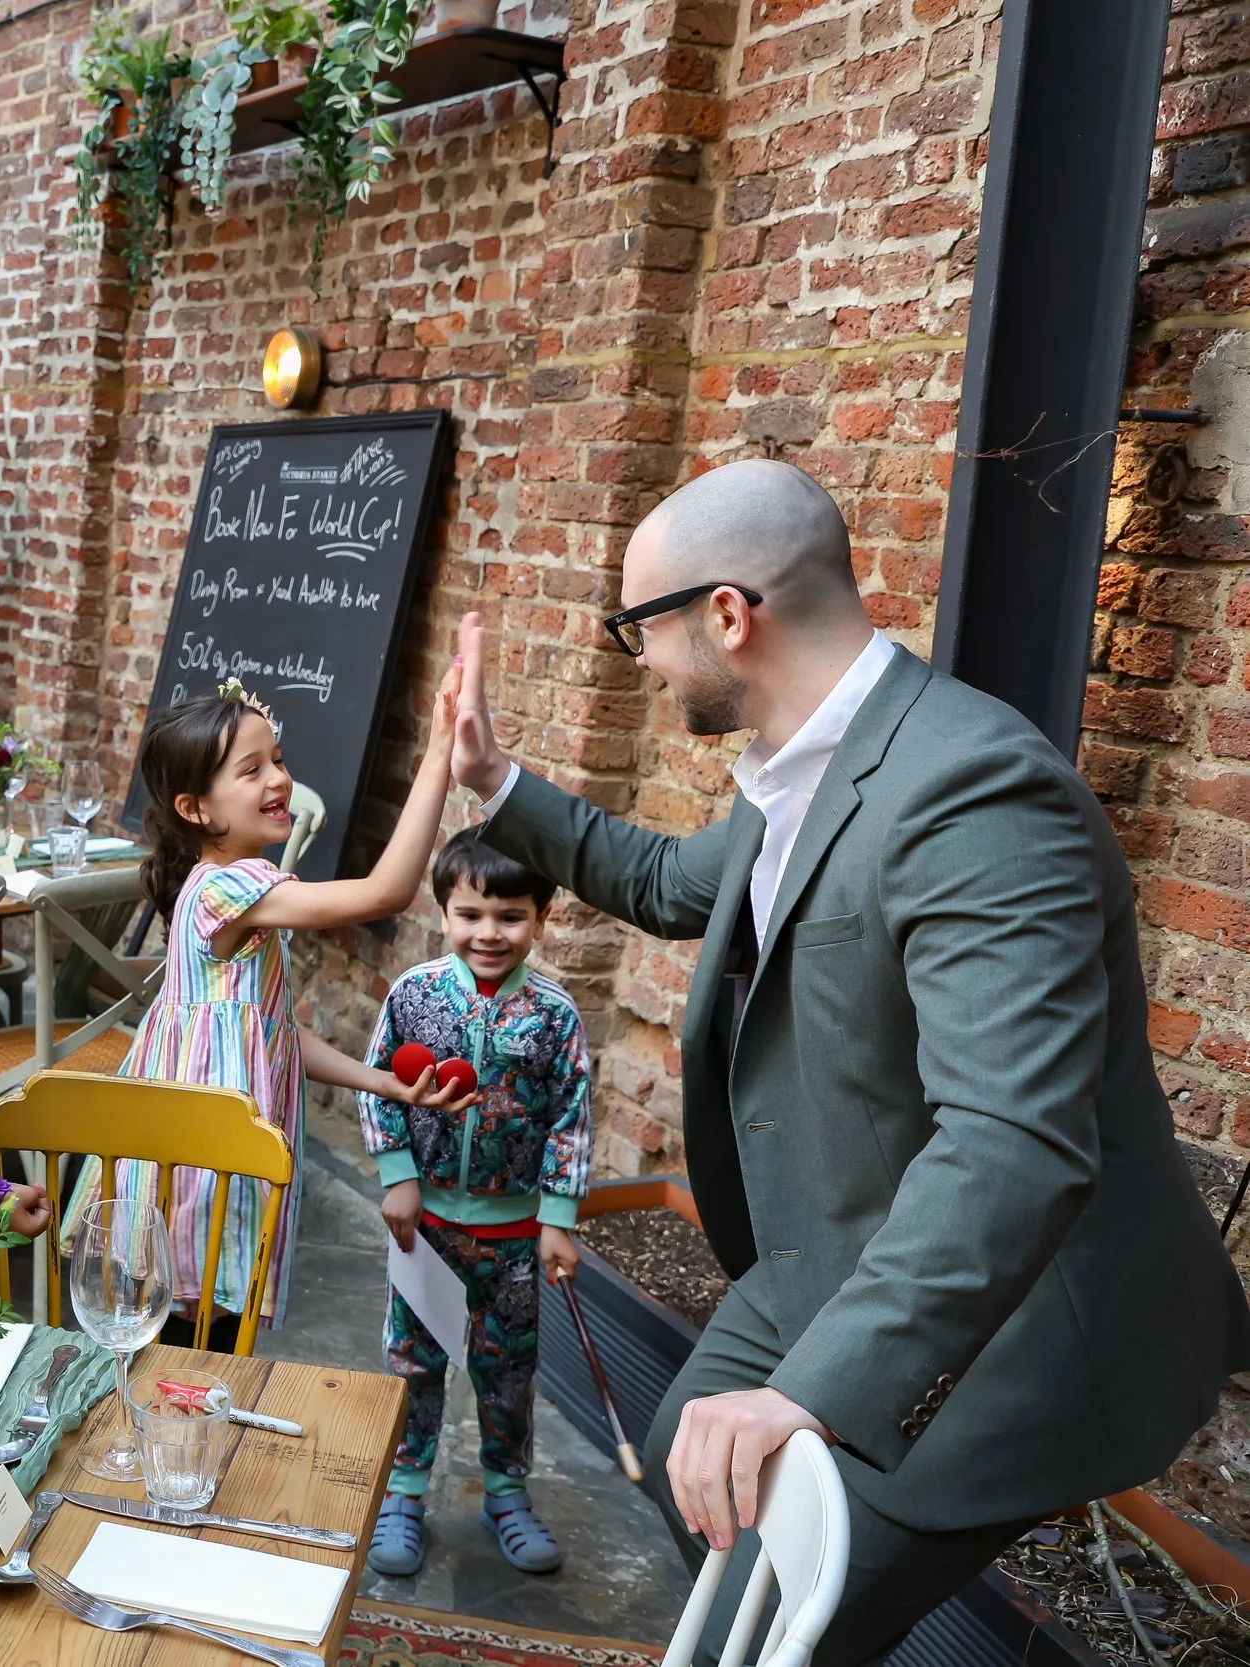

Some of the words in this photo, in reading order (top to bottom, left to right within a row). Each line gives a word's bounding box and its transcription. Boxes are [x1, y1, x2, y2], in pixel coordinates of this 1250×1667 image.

[203, 485, 241, 543] Book
[242, 483, 274, 542] Now
[309, 494, 356, 539] World
[358, 496, 403, 550] Cup!
[221, 567, 249, 603] Room
[177, 631, 214, 671] 50%
